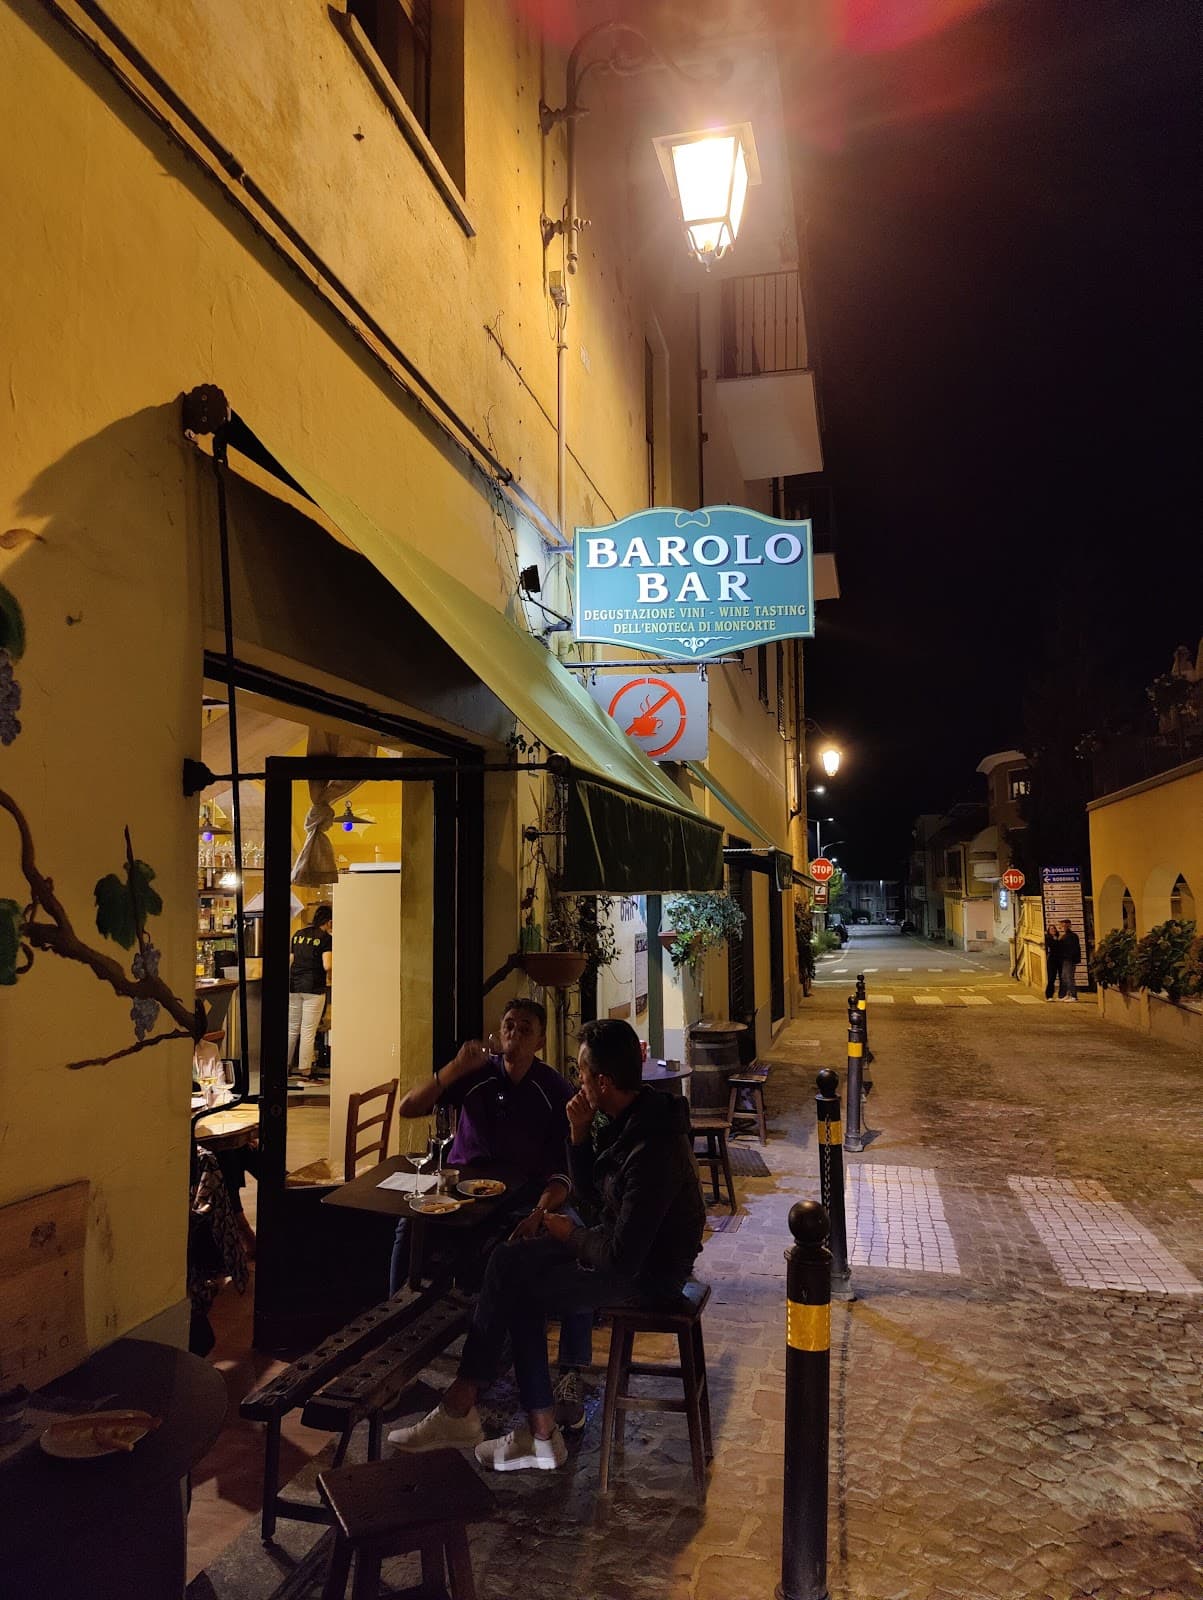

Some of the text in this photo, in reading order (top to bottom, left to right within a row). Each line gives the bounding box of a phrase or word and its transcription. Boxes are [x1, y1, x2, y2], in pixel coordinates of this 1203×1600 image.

[586, 533, 802, 567] BAROLO
[636, 570, 752, 603] BAR
[584, 608, 675, 620] DEGUSTAZIONE
[679, 607, 705, 618] VINI
[720, 606, 750, 617] WINE
[754, 605, 806, 616] TASTING
[613, 620, 776, 634] DELL'ENOTECA DI MONFORTE
[812, 865, 832, 874] STOP
[1004, 875, 1024, 884] STOP
